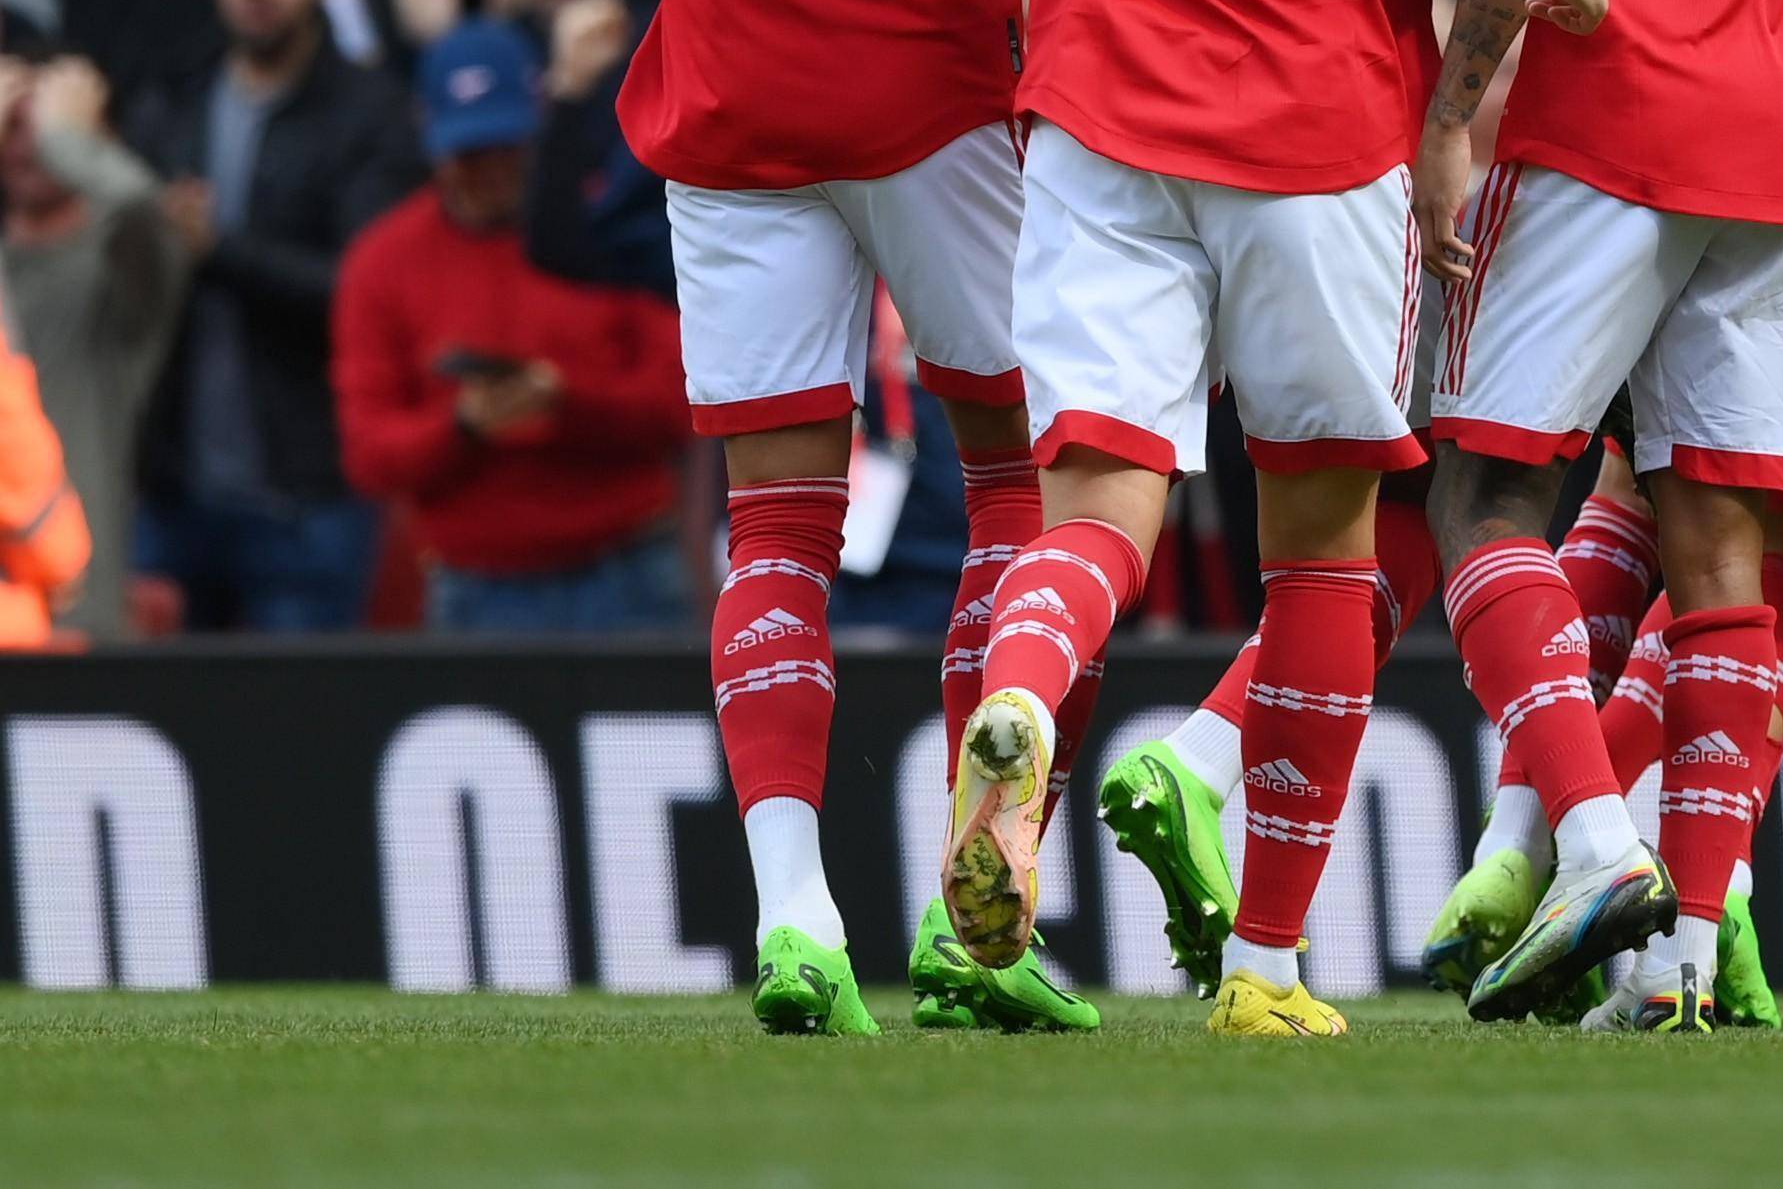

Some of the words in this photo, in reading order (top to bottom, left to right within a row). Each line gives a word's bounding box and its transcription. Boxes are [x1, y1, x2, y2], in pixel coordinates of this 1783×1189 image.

[723, 624, 818, 656] adidas
[1671, 747, 1750, 769] adidas
[1244, 771, 1322, 798] adidas
